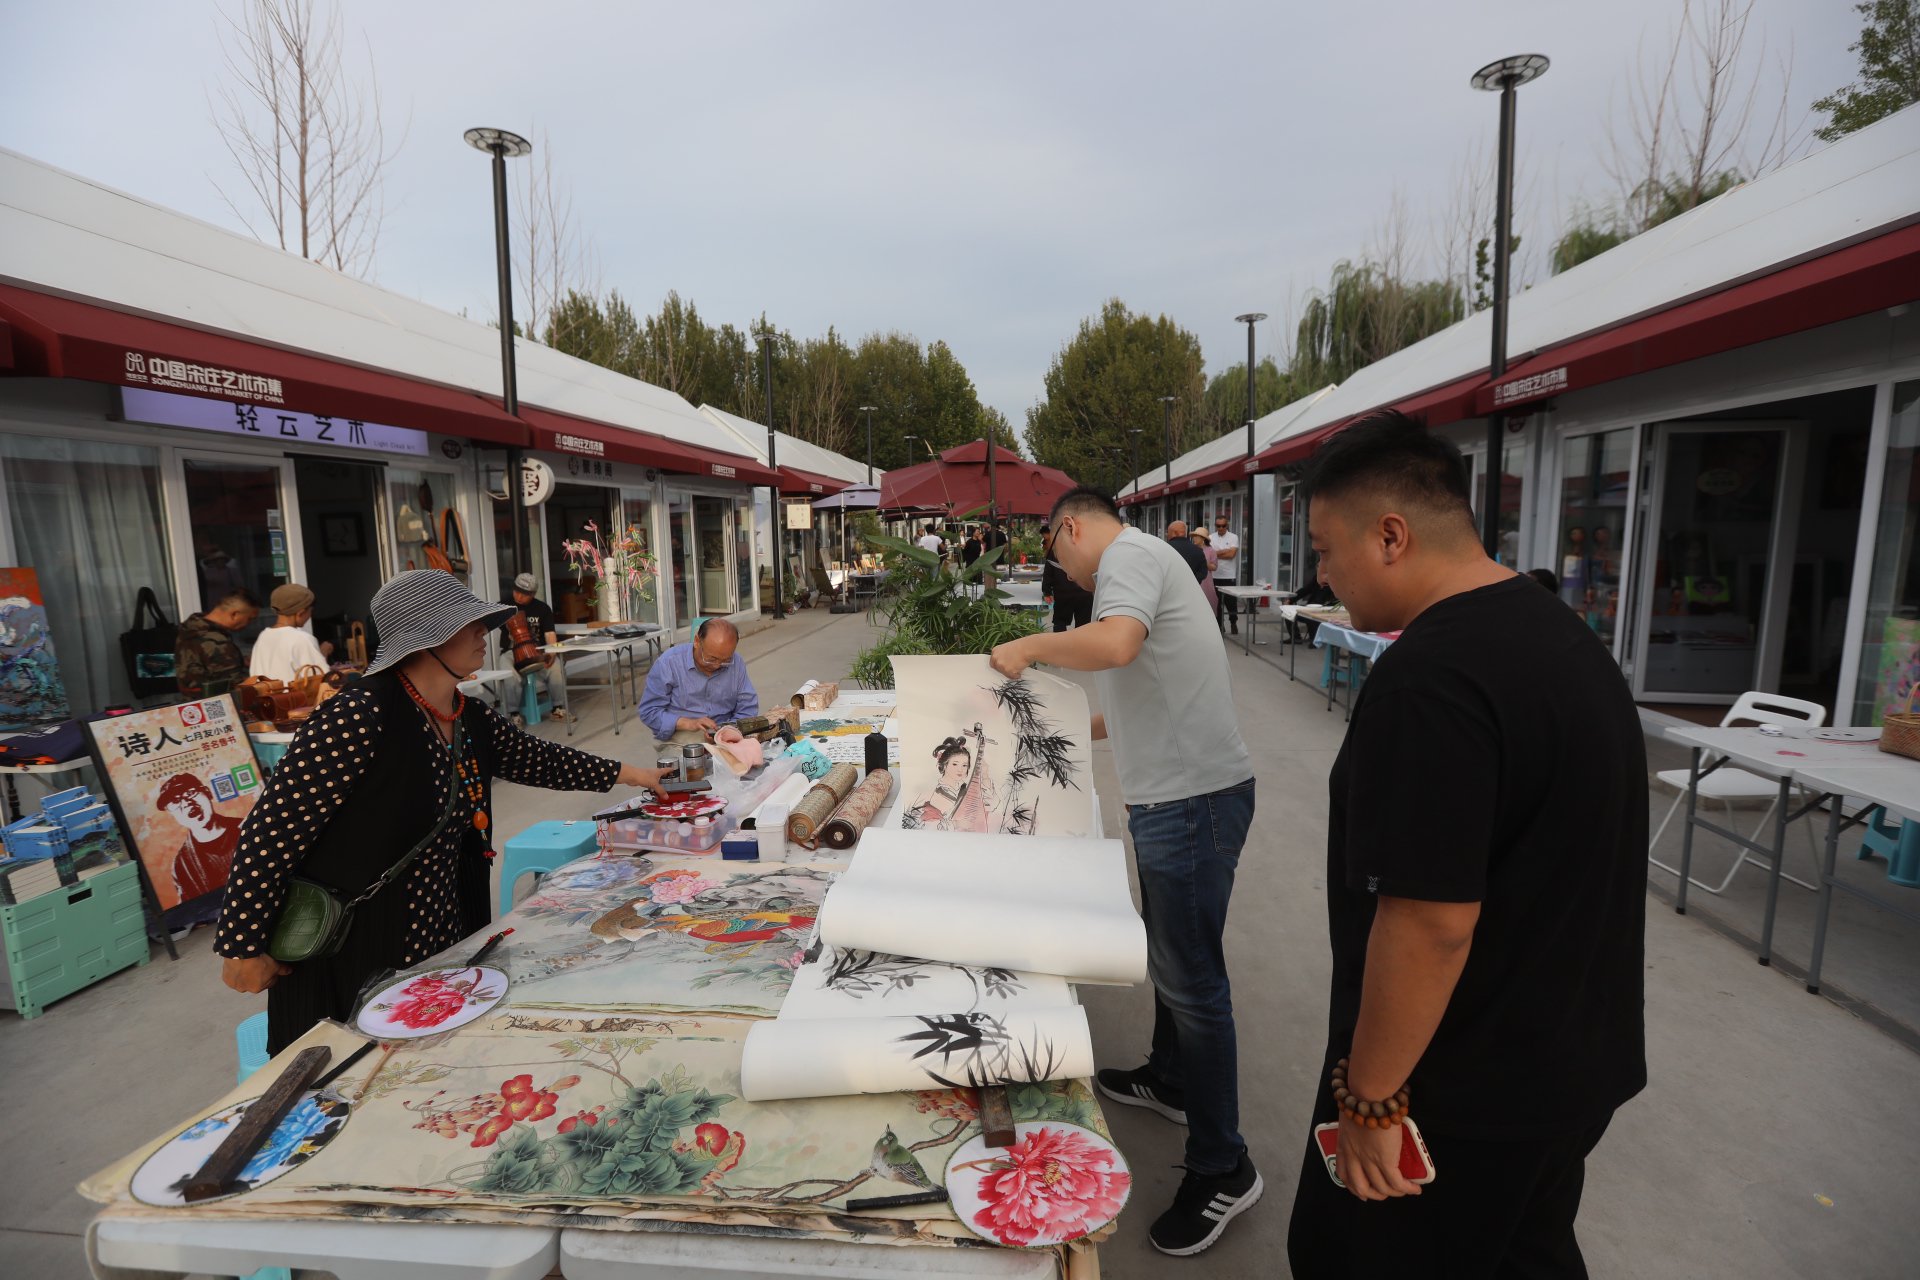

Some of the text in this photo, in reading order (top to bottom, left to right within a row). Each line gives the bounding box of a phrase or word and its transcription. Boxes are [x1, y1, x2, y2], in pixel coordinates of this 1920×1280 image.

[150, 357, 282, 396] 中国宋庄艺术市集
[152, 378, 208, 392] SONGZHUANG
[209, 387, 222, 395] ART
[224, 389, 252, 399] MARKET
[264, 395, 285, 404] CHINA
[235, 402, 367, 445] 轻云艺术
[118, 726, 182, 758] 诗人
[201, 735, 237, 751] 签名售书
